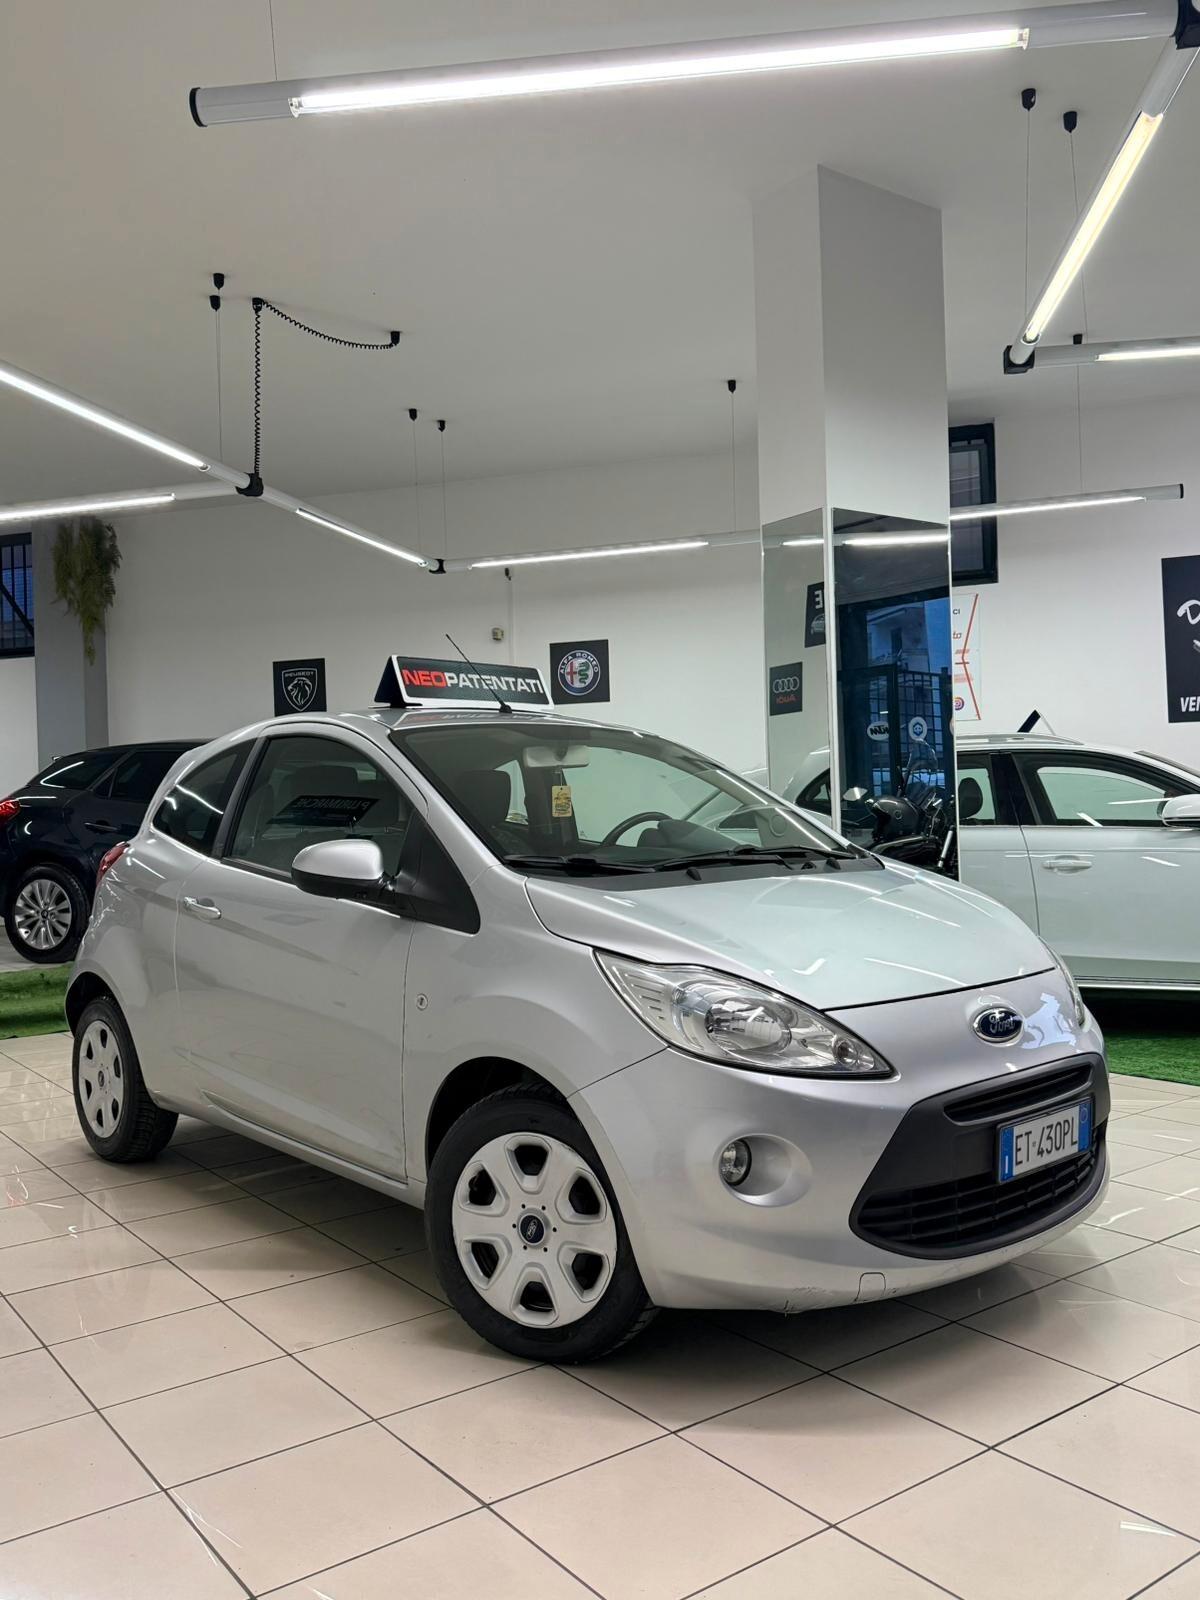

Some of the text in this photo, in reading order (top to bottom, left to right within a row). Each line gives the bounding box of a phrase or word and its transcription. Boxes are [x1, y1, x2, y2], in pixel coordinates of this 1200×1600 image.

[576, 652, 599, 673] ROMEO
[400, 668, 545, 694] NEOPATENTATI
[988, 1010, 1016, 1034] Ford
